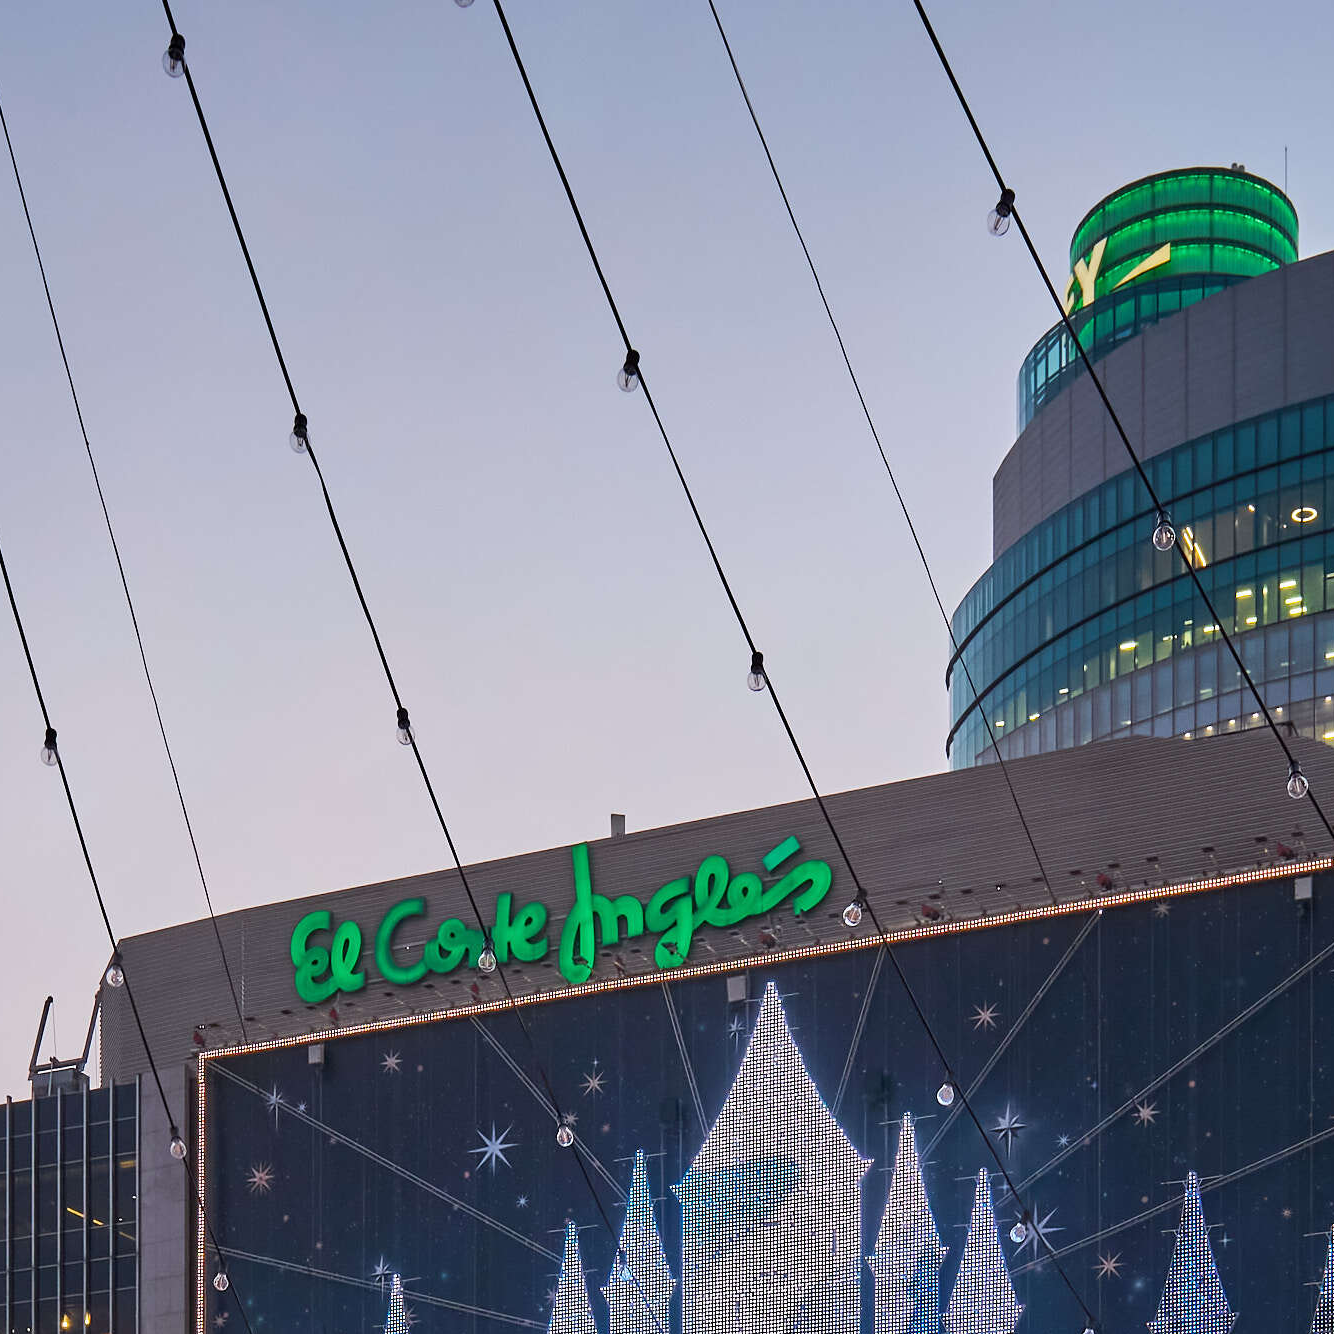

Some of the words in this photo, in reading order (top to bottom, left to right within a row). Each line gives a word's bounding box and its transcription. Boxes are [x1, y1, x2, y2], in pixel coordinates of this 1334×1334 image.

[290, 911, 365, 1003] El
[375, 896, 549, 985] Corte
[559, 835, 833, 984] Inglés
